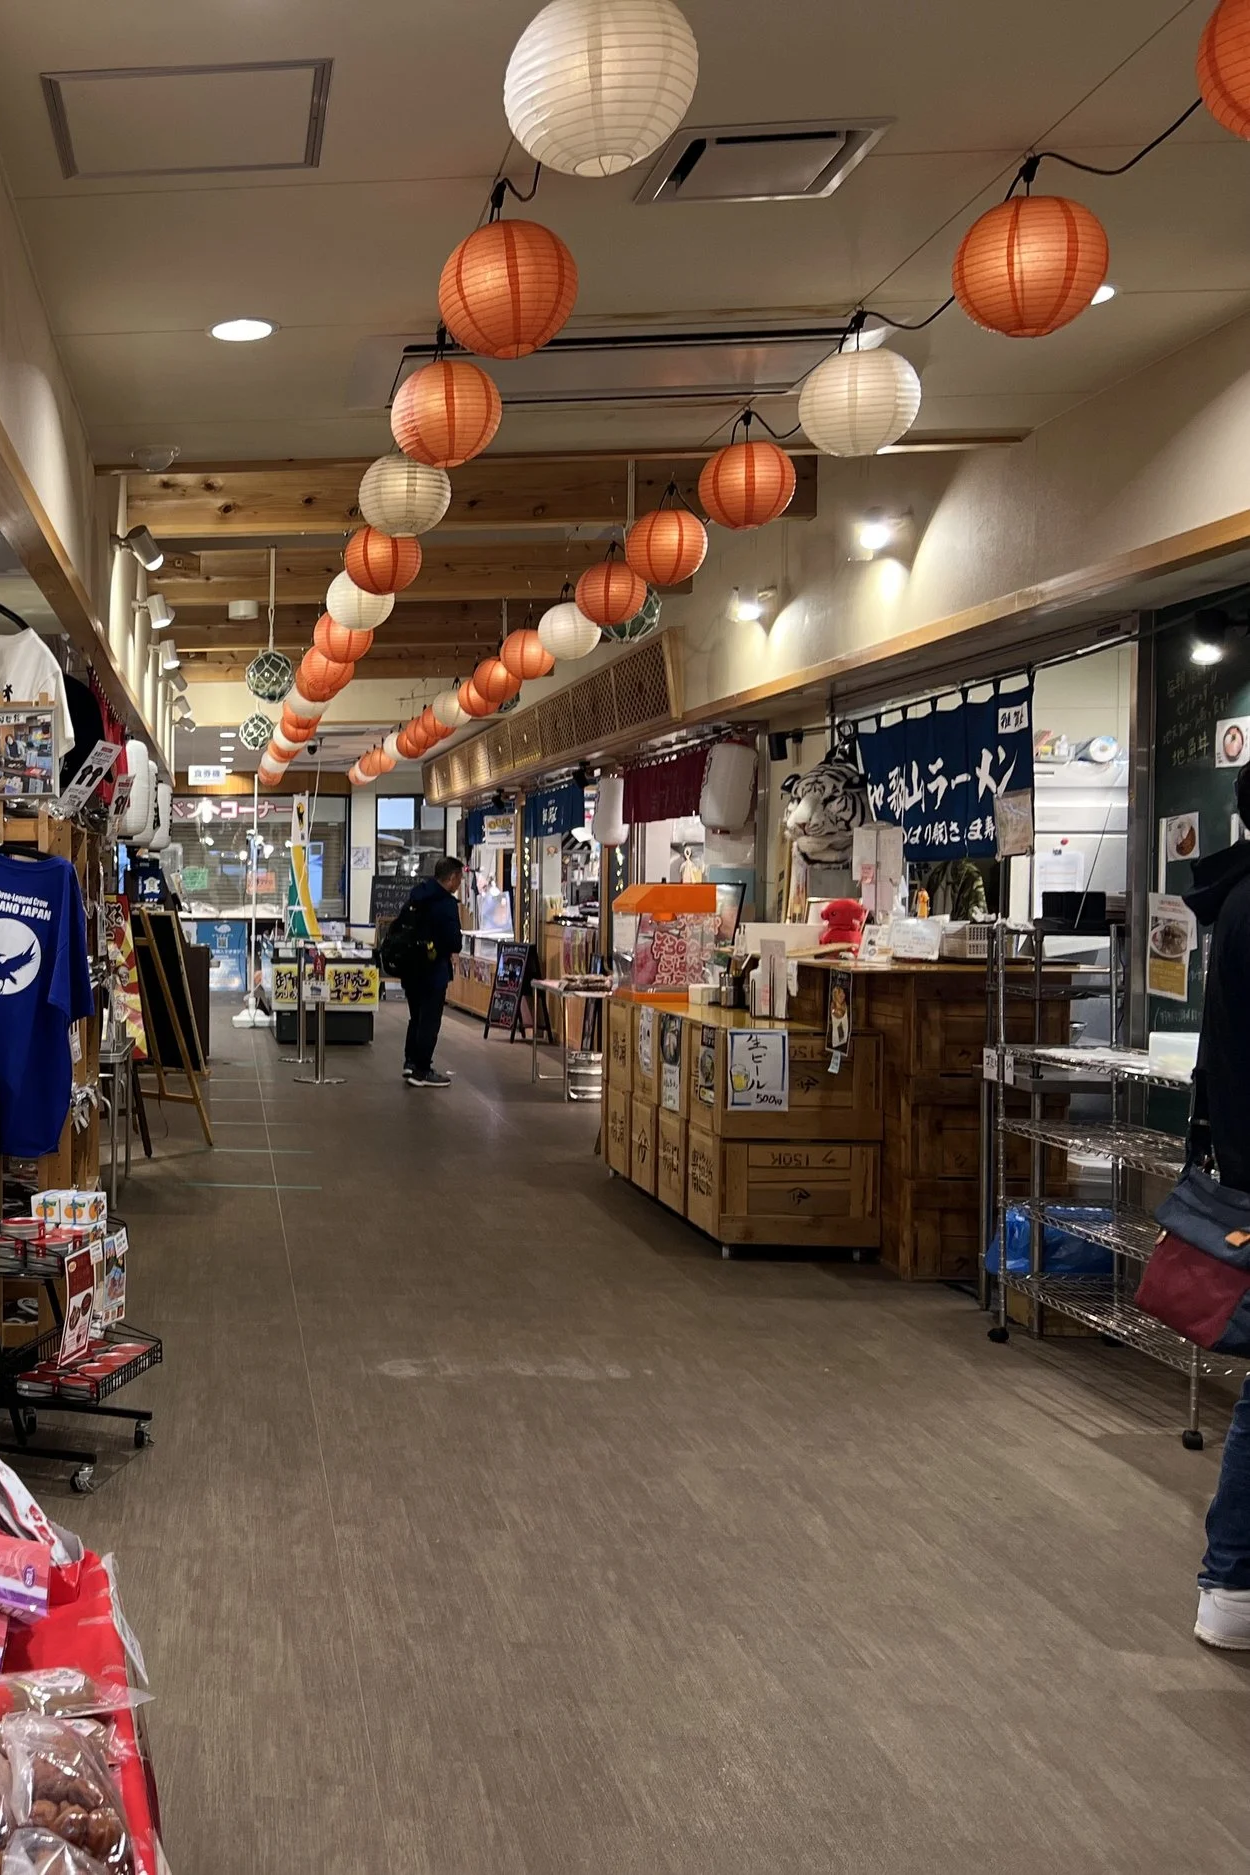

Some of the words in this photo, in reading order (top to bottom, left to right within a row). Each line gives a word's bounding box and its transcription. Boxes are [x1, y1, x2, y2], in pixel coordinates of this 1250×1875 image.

[33, 898, 48, 908] Crow
[21, 905, 52, 921] JAPAN
[334, 969, 370, 991] 卸売
[330, 989, 375, 1005] コーナー
[747, 1034, 768, 1091] 生ビール
